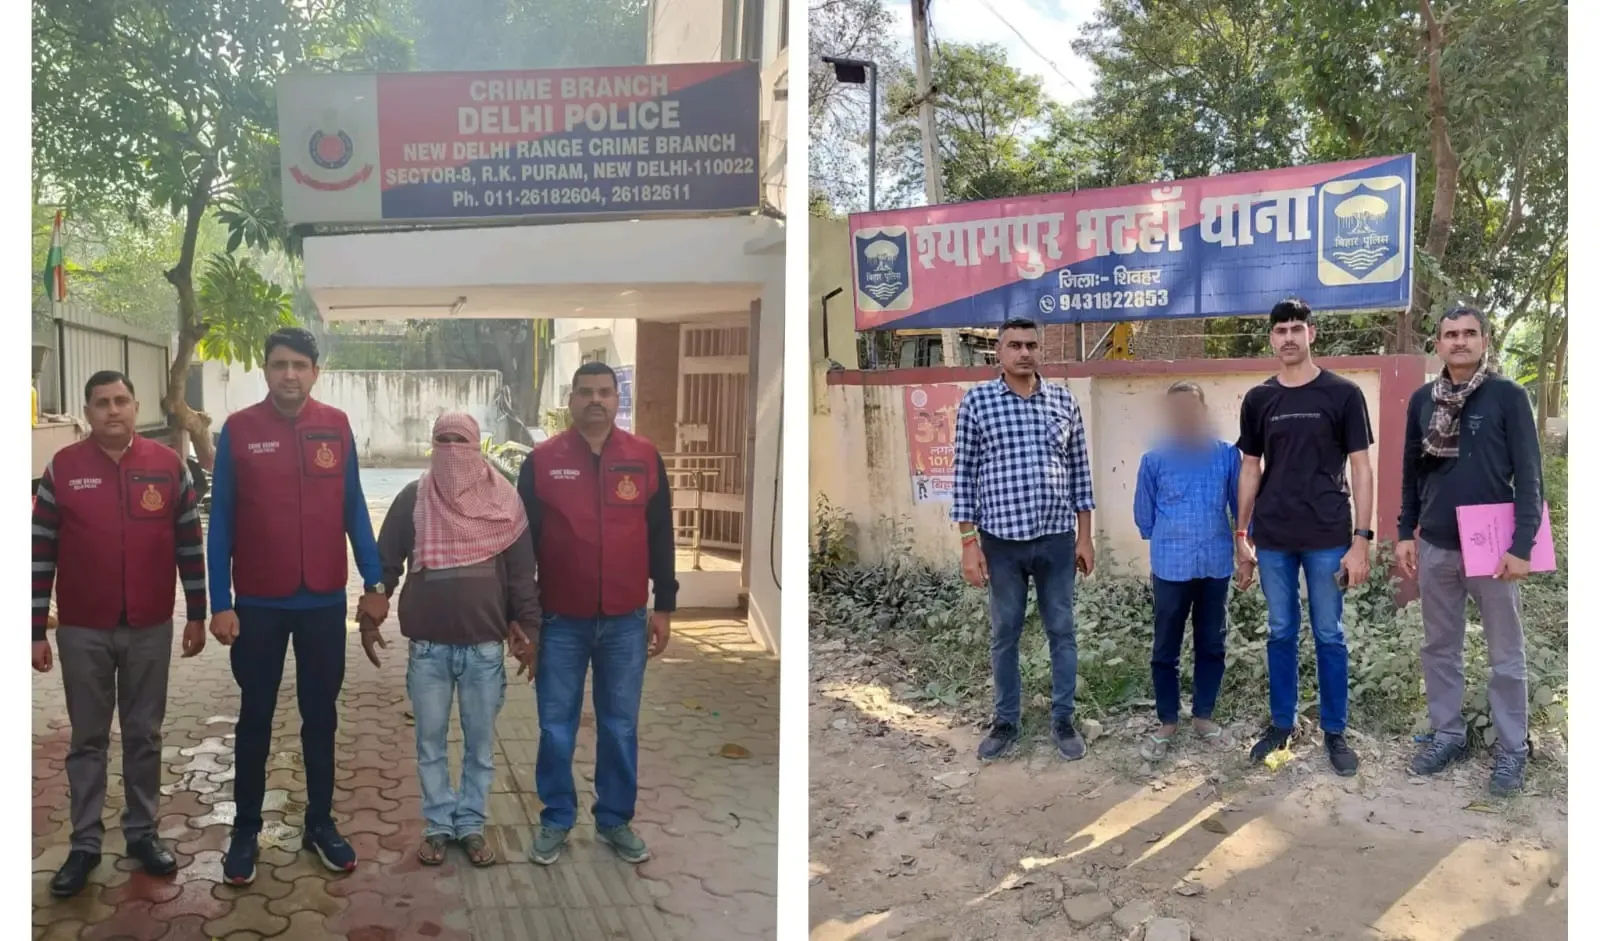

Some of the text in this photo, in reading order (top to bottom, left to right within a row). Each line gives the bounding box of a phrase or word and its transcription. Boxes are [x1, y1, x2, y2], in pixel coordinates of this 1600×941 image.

[470, 75, 667, 102] CRIME BRANCH
[458, 101, 680, 134] DELHI POLICE
[404, 134, 735, 162] NEW DELHI RANGE CRIME BRANCH
[385, 158, 754, 187] SECTOR-8, R.K. PURAM, NEW DELHI-110022
[453, 184, 690, 207] Ph. 011-26182604, 26182611
[913, 212, 1065, 279] श्यामपुर
[1199, 186, 1317, 247] थाना
[1113, 265, 1162, 286] शिवहर
